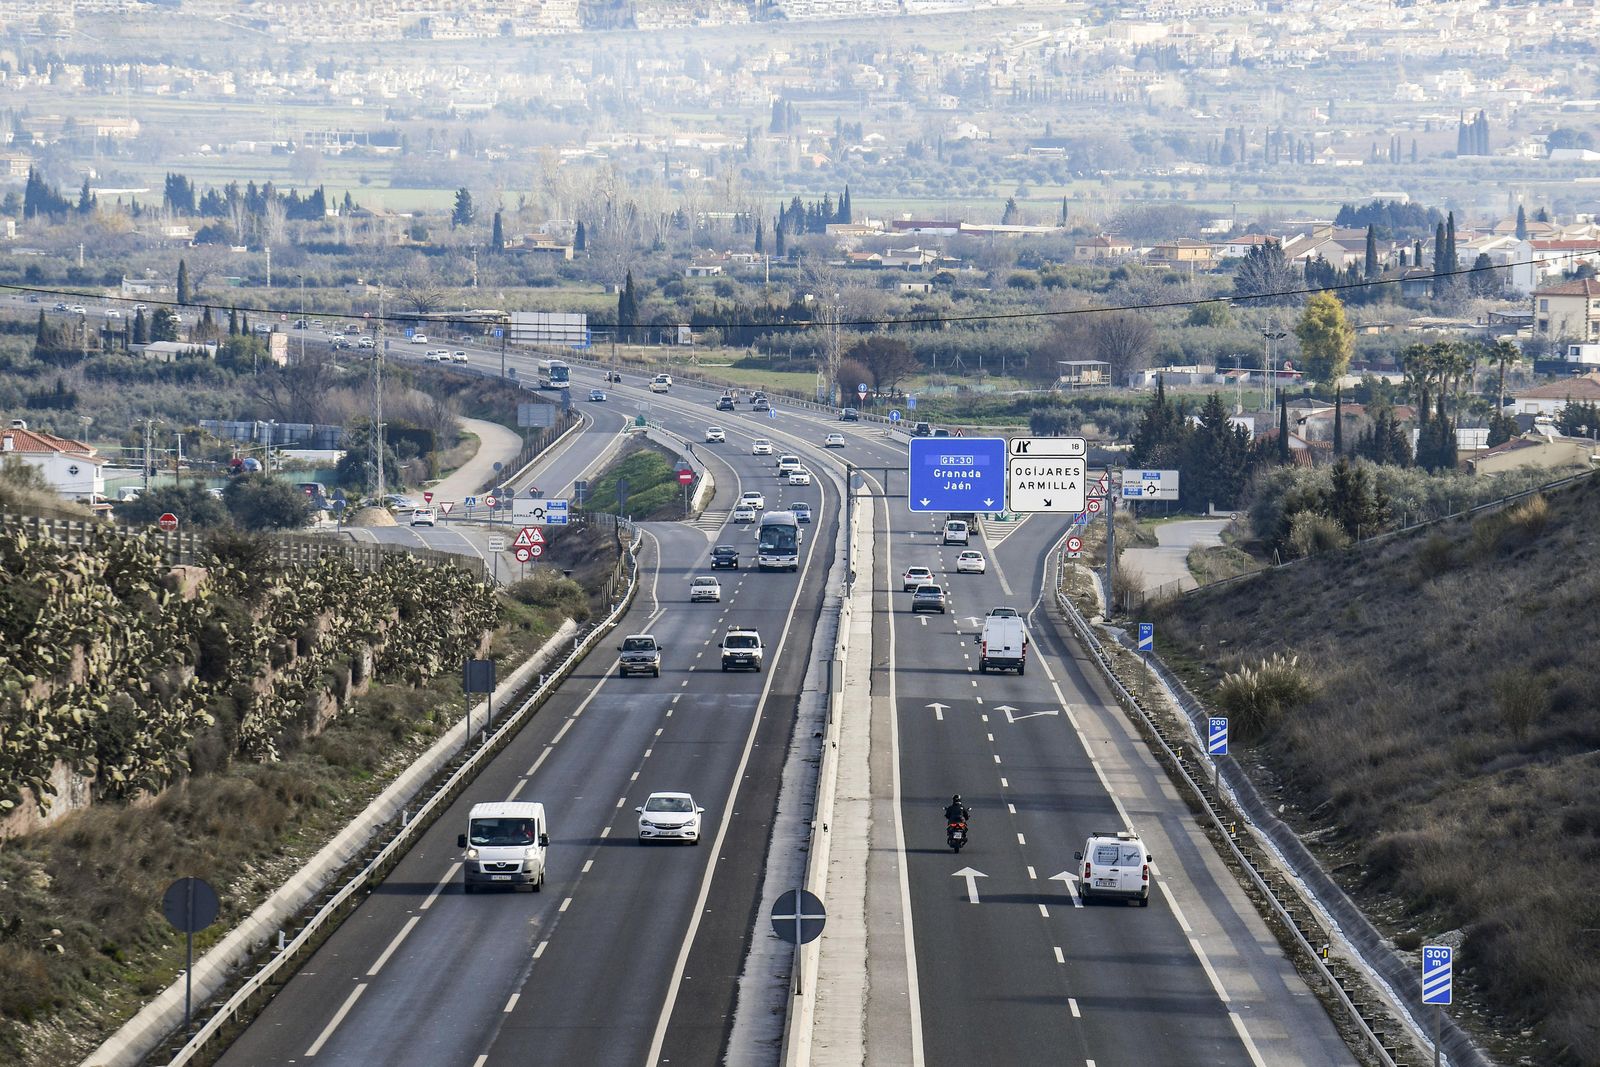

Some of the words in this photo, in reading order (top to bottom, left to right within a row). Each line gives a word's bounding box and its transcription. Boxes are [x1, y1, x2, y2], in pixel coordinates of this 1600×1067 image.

[933, 469, 981, 478] Granada
[1015, 466, 1080, 476] OGÍJARES
[943, 481, 972, 490] Jaén
[1018, 481, 1076, 490] ARMILLA
[1426, 949, 1448, 959] 300
